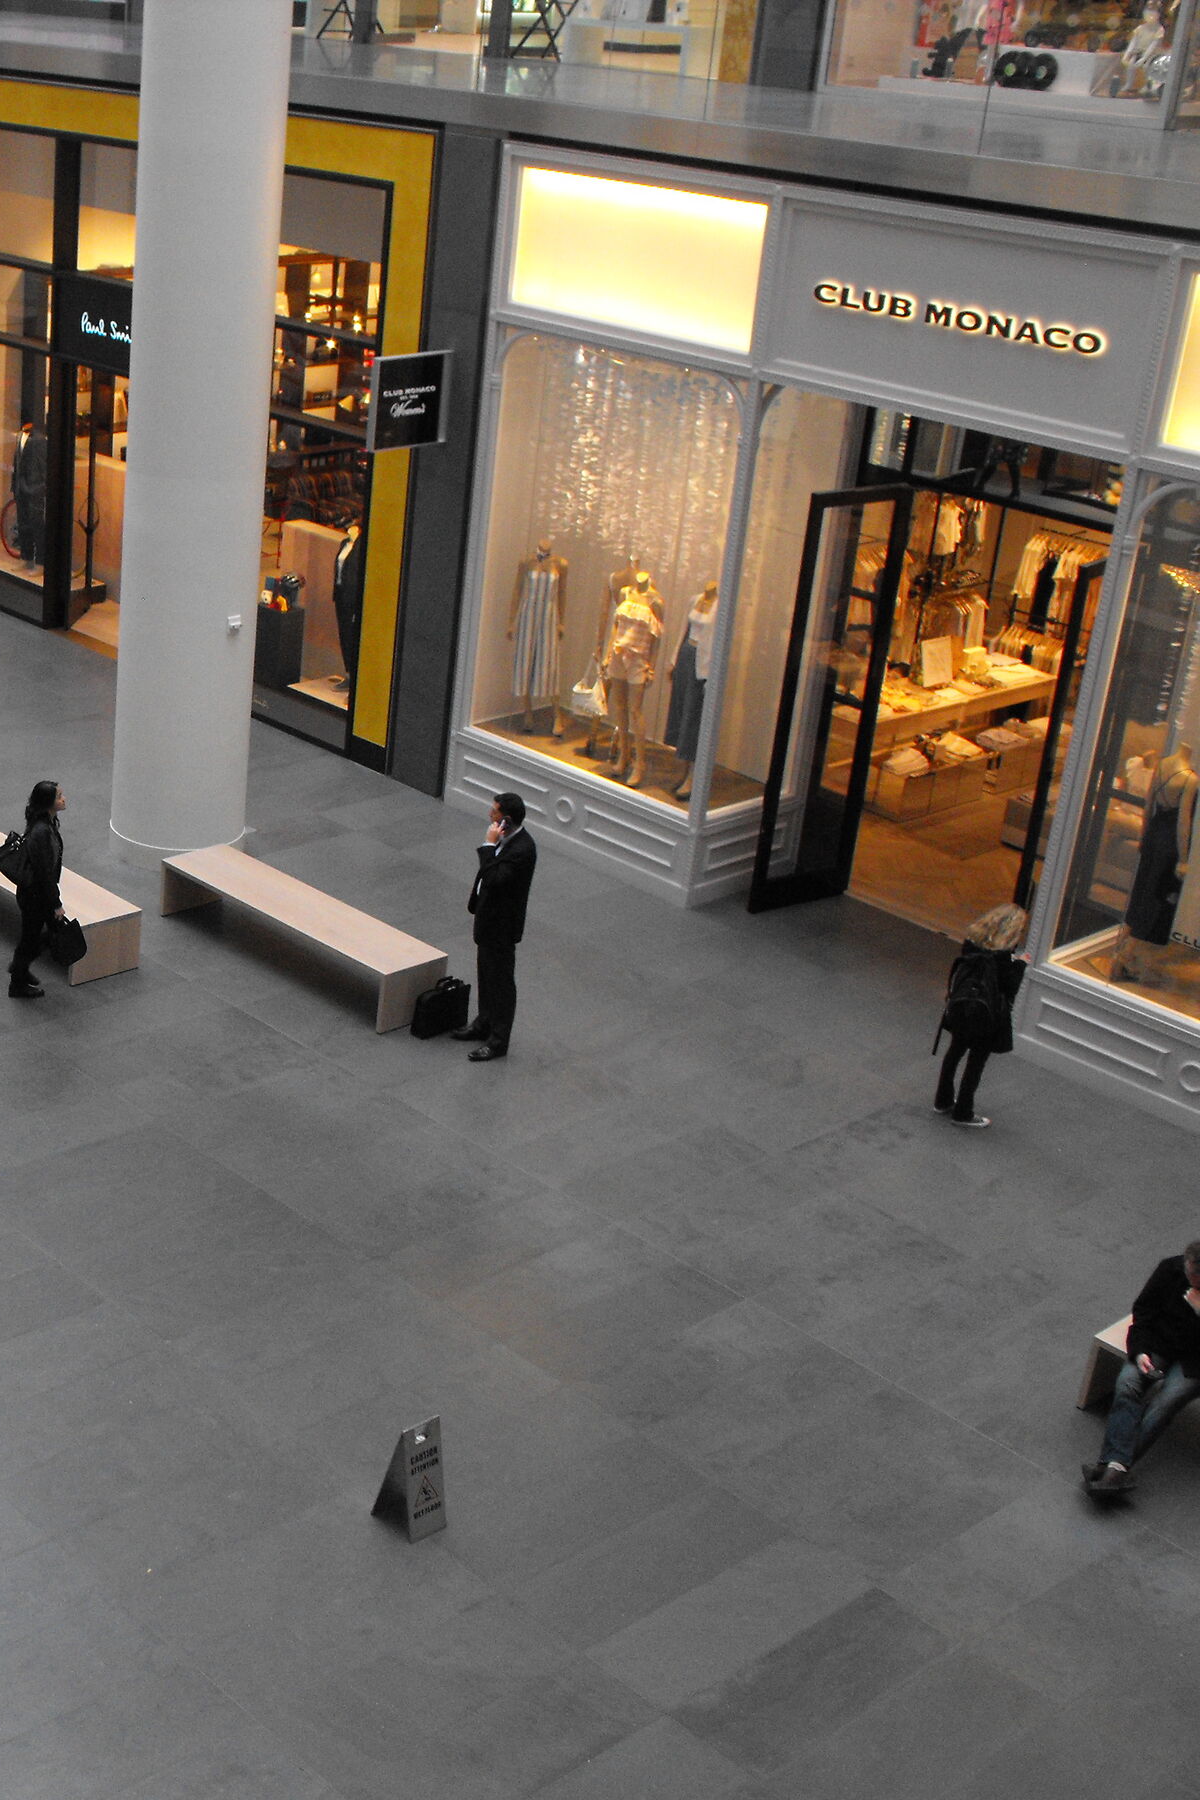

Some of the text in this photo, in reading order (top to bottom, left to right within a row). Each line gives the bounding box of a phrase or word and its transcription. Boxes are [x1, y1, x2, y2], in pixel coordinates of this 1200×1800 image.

[81, 311, 107, 337] Paul
[813, 282, 1103, 354] CLUB MONACO
[383, 389, 404, 398] CLUB
[404, 385, 437, 394] MONACO
[410, 1445, 438, 1466] CAUTION
